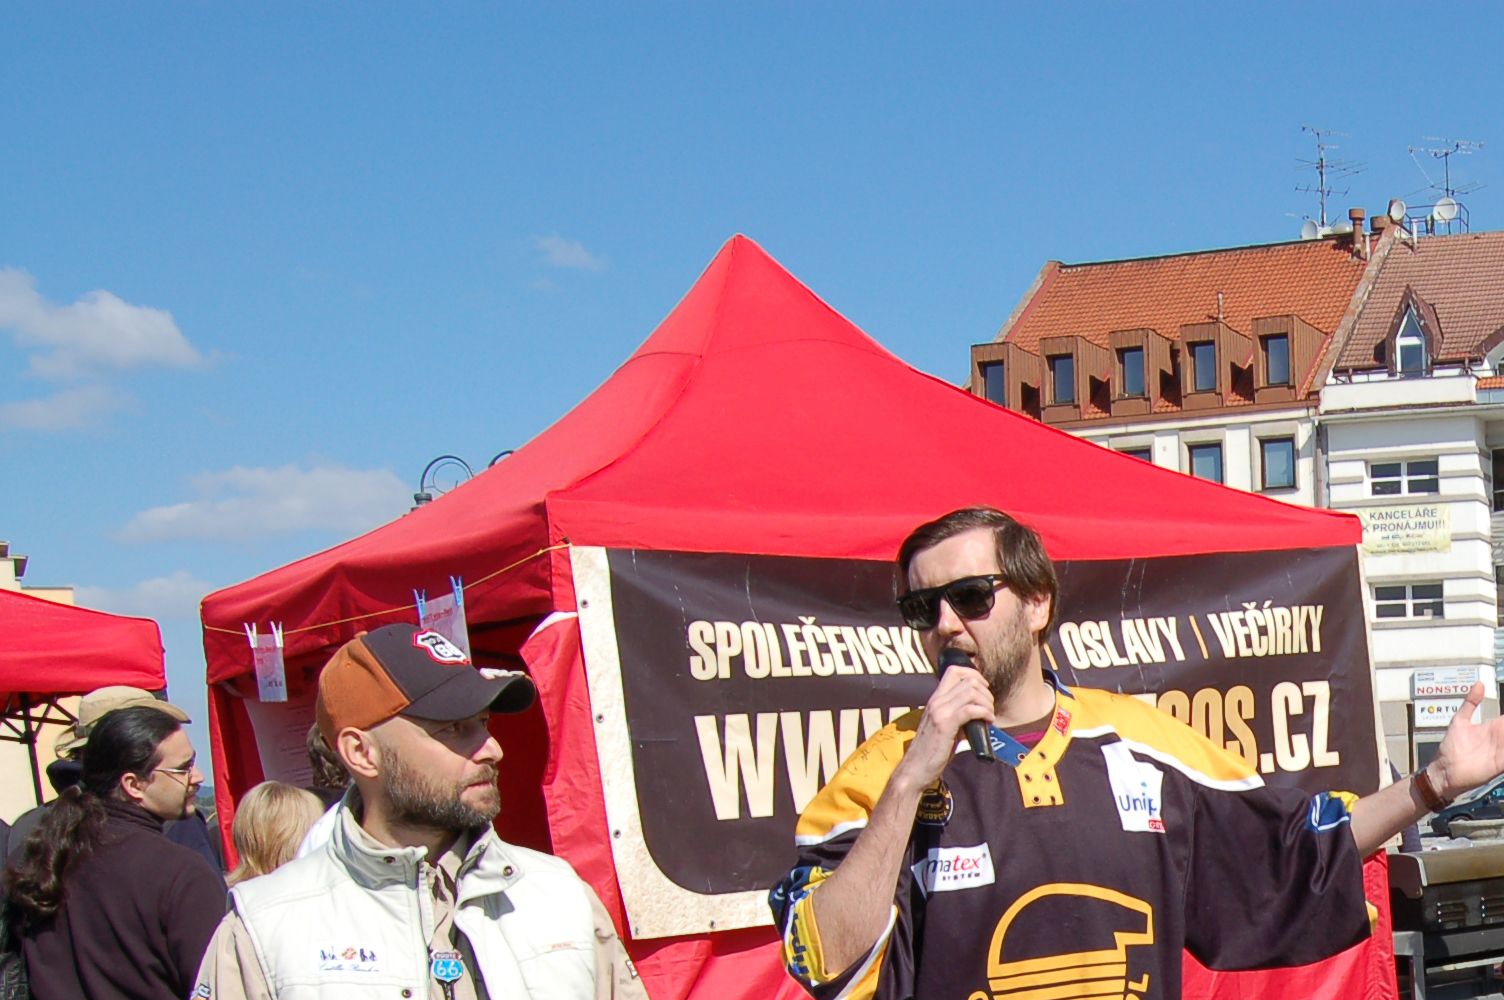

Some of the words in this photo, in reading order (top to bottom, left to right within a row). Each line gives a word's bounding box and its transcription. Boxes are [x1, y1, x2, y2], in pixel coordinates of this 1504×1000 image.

[1369, 507, 1438, 521] KANCELÁŘE
[1059, 616, 1186, 670] OSLAVY
[1208, 600, 1324, 659] VEČÍRKY
[1417, 685, 1473, 694] NONSTO
[436, 960, 459, 977] 66
